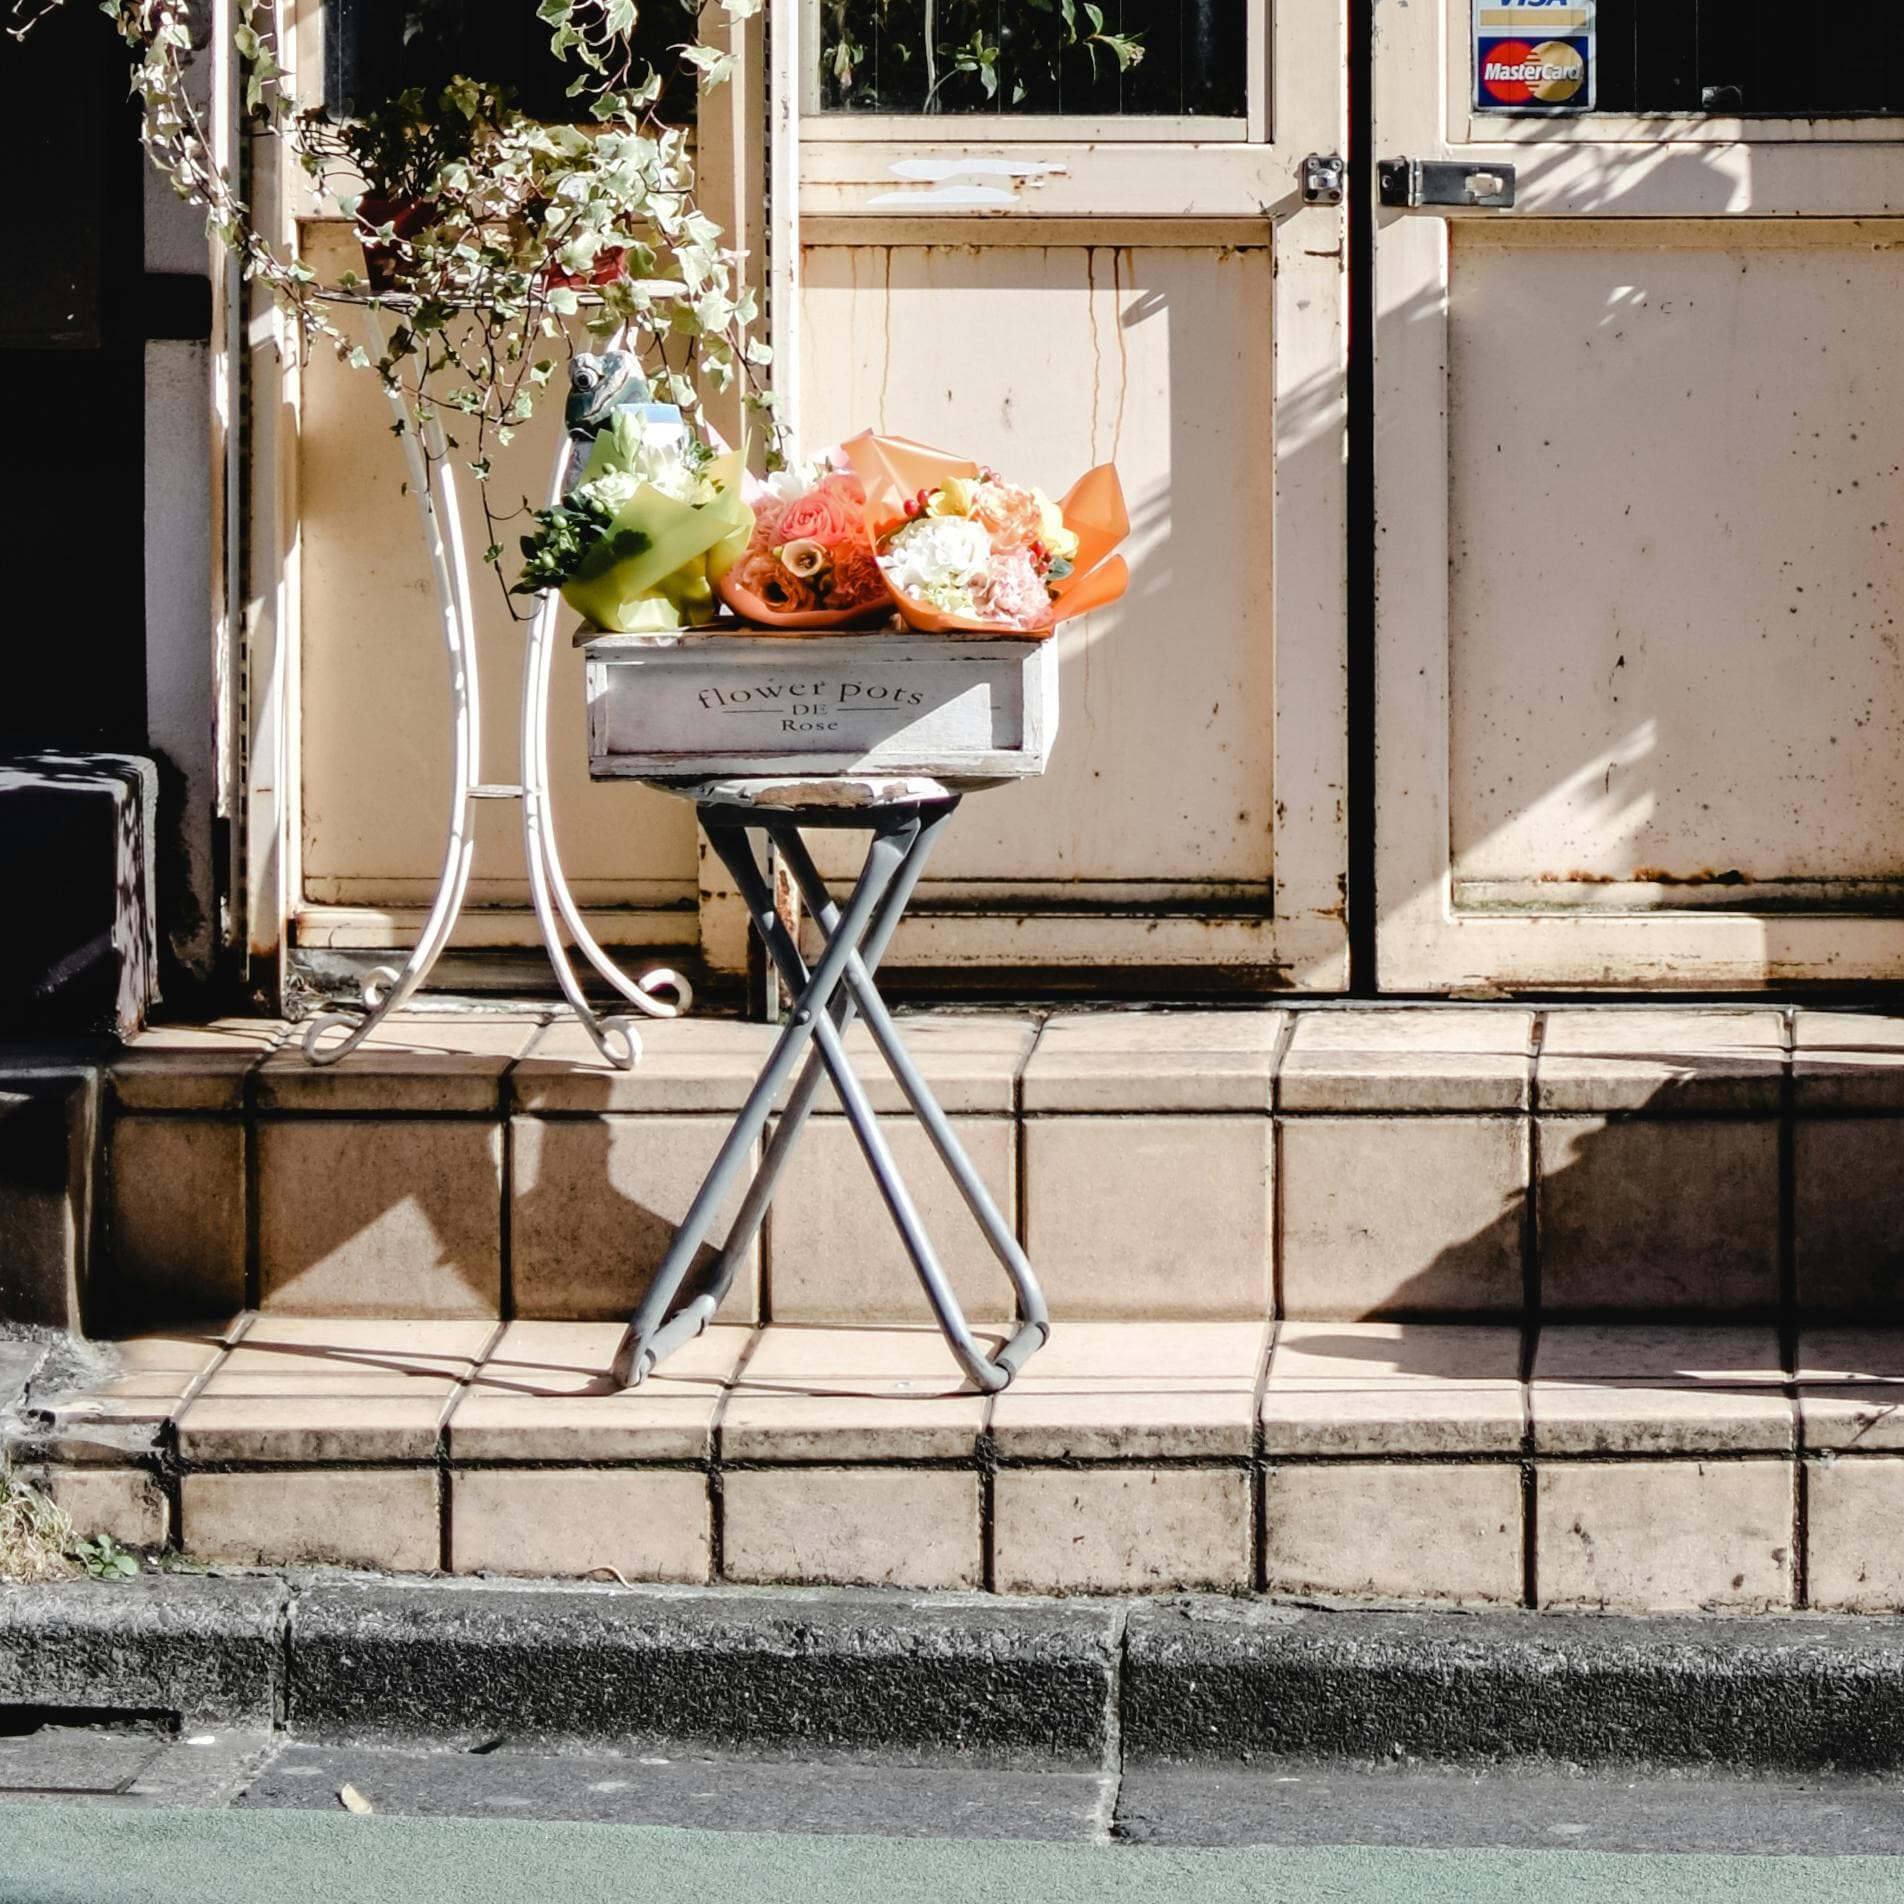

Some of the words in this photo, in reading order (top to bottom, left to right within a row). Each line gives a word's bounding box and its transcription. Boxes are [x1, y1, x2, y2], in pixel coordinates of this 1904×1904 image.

[1484, 62, 1581, 81] MasterCard
[697, 680, 826, 710] flower
[839, 681, 924, 705] pots
[792, 703, 828, 716] DE
[780, 719, 839, 732] Rose
